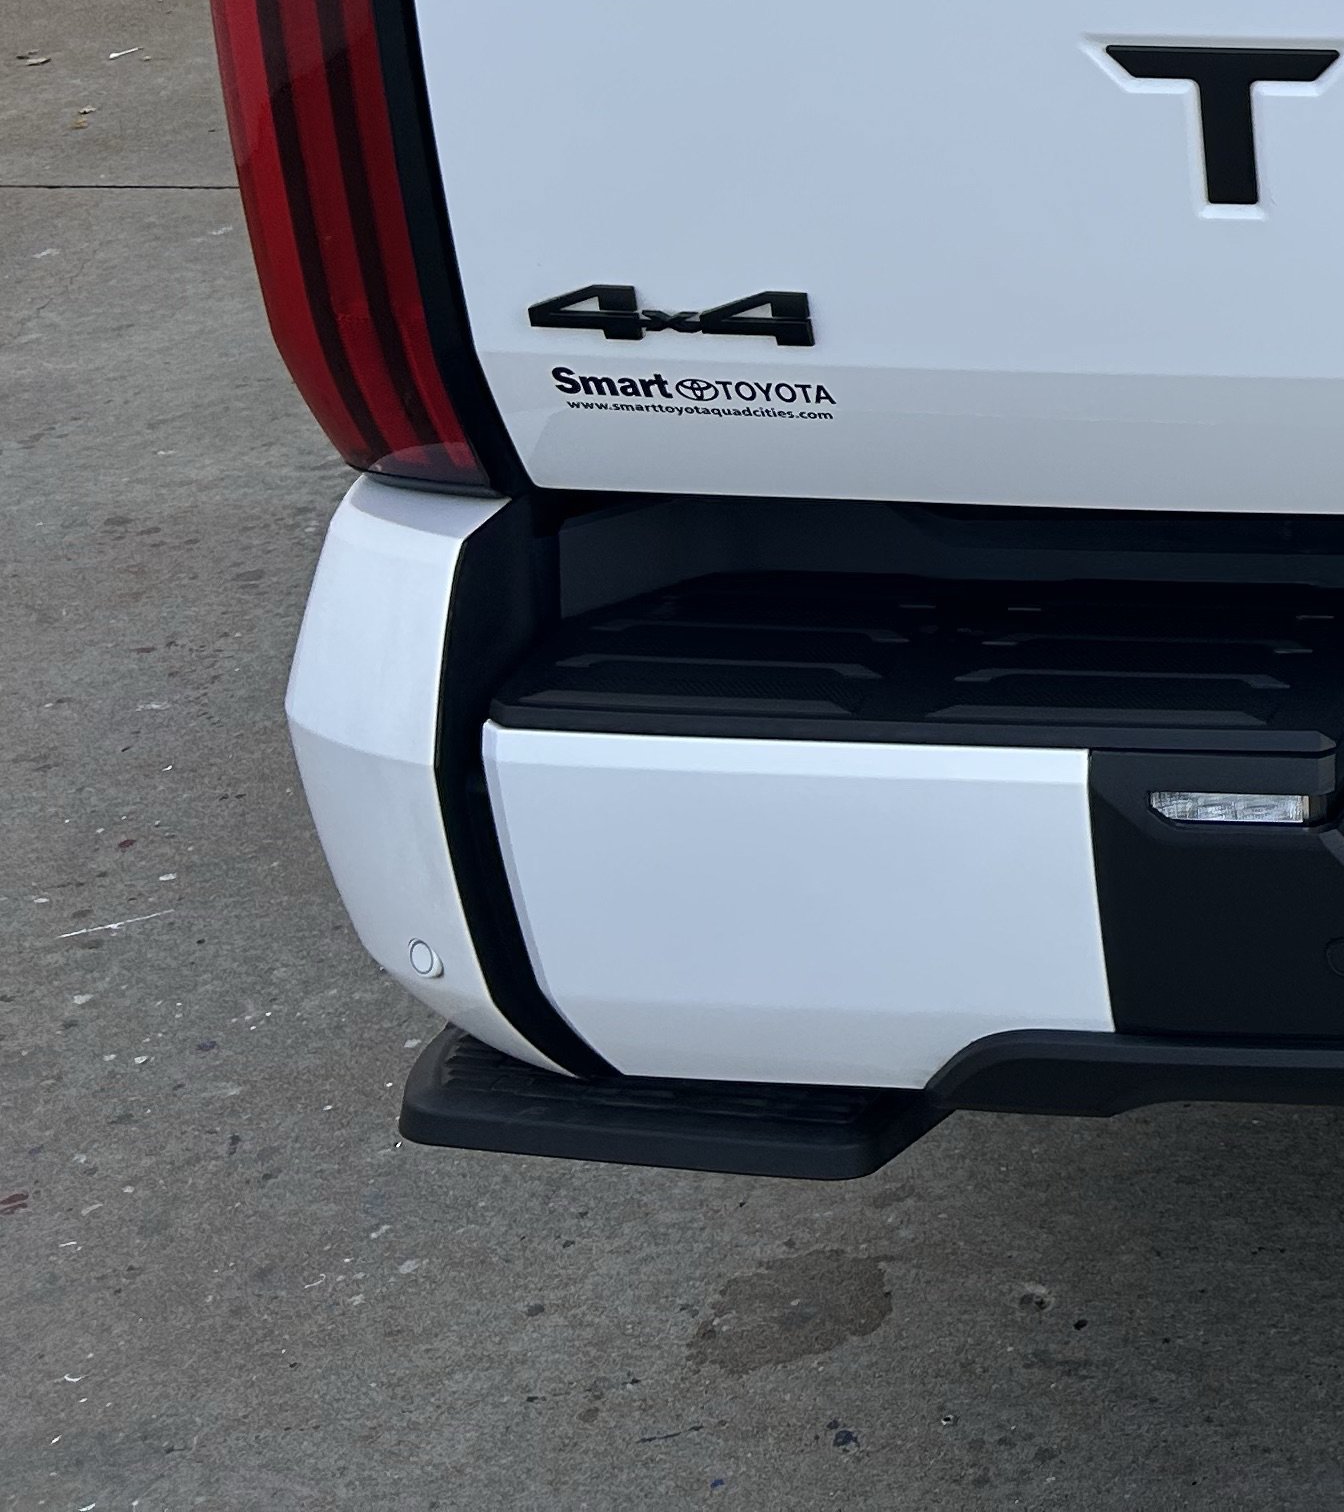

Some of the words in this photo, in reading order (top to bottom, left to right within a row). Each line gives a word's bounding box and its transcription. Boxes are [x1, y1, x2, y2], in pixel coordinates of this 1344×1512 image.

[551, 366, 673, 399] Smart
[714, 380, 837, 405] TOYOTA
[567, 399, 834, 420] www.smarttoyotaquadcities.com
